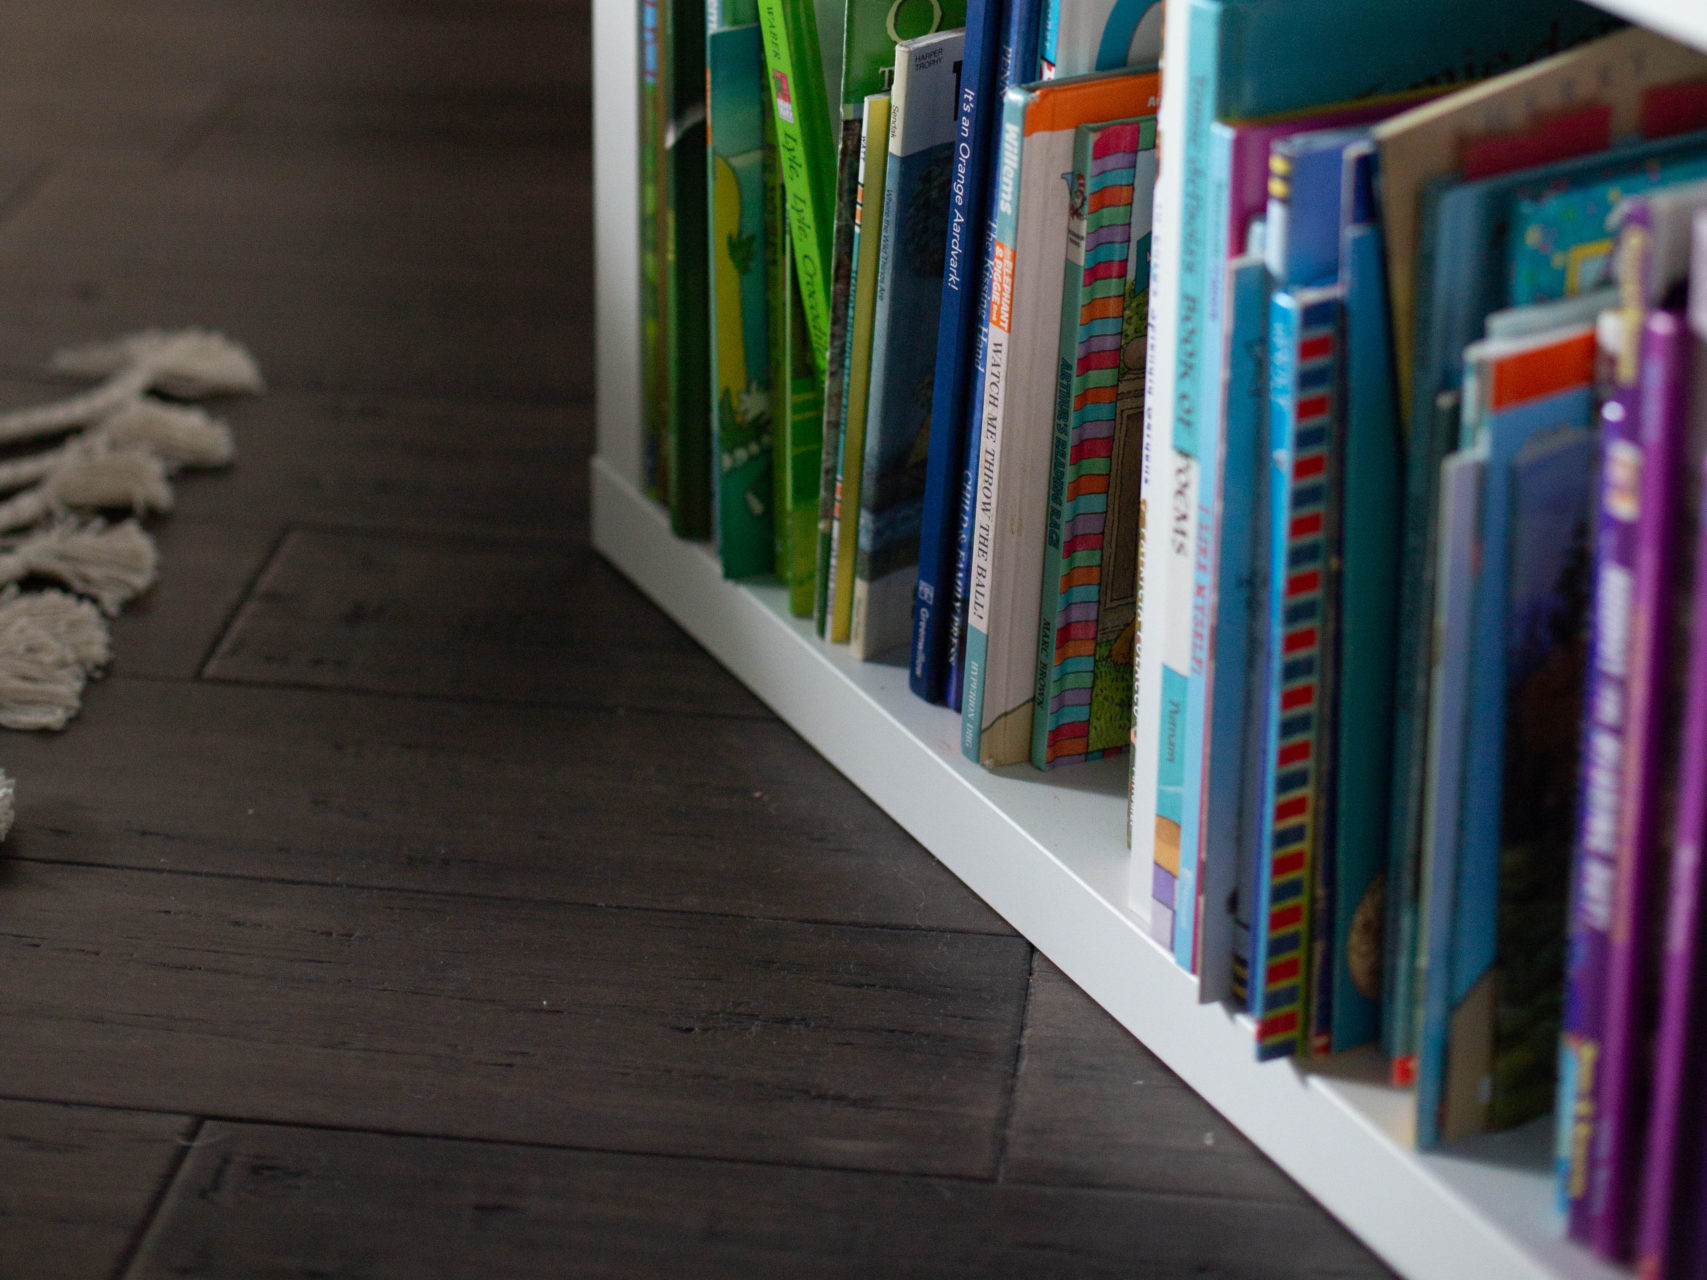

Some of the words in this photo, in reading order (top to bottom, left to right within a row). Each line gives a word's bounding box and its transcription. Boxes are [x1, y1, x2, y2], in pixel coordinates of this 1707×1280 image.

[766, 6, 782, 61] WABER
[914, 47, 944, 63] HARPER
[915, 57, 944, 72] TROPHY
[890, 104, 899, 138] Sendak
[962, 88, 976, 113] It's
[960, 116, 971, 138] an
[782, 132, 802, 181] Lyle,
[953, 142, 971, 206] Orange
[1000, 123, 1020, 215] Willems
[790, 193, 811, 242] Lyle,
[882, 220, 891, 233] the
[883, 189, 894, 217] Where
[881, 234, 891, 255] Wild
[947, 209, 965, 290] Aardvark!
[985, 220, 999, 248] The
[994, 245, 1004, 257] &
[878, 287, 886, 302] Are
[879, 256, 889, 283] Things
[977, 257, 995, 322] Kissing
[991, 258, 1003, 304] PIGGIE
[999, 259, 1014, 330] ELEPHANT
[801, 254, 828, 364] Crocodile
[974, 323, 990, 373] Hand
[988, 342, 1004, 409] WATCH
[1056, 357, 1073, 435] ARTHUR'S
[985, 412, 998, 443] ME
[981, 447, 996, 519] THROW
[1051, 436, 1068, 505] READING
[960, 470, 973, 528] CHILD
[1170, 449, 1194, 558] POEMS
[977, 523, 990, 561] THE
[1047, 506, 1063, 551] RACE
[1195, 522, 1211, 573] LIKE
[951, 548, 967, 611] FAMILY
[973, 564, 988, 620] BALL!
[915, 607, 930, 679] Greenwillow
[1040, 618, 1051, 658] MARC
[1190, 582, 1208, 676] MYSELF!
[967, 660, 980, 720] HYPERION
[1036, 660, 1049, 711] BROWN
